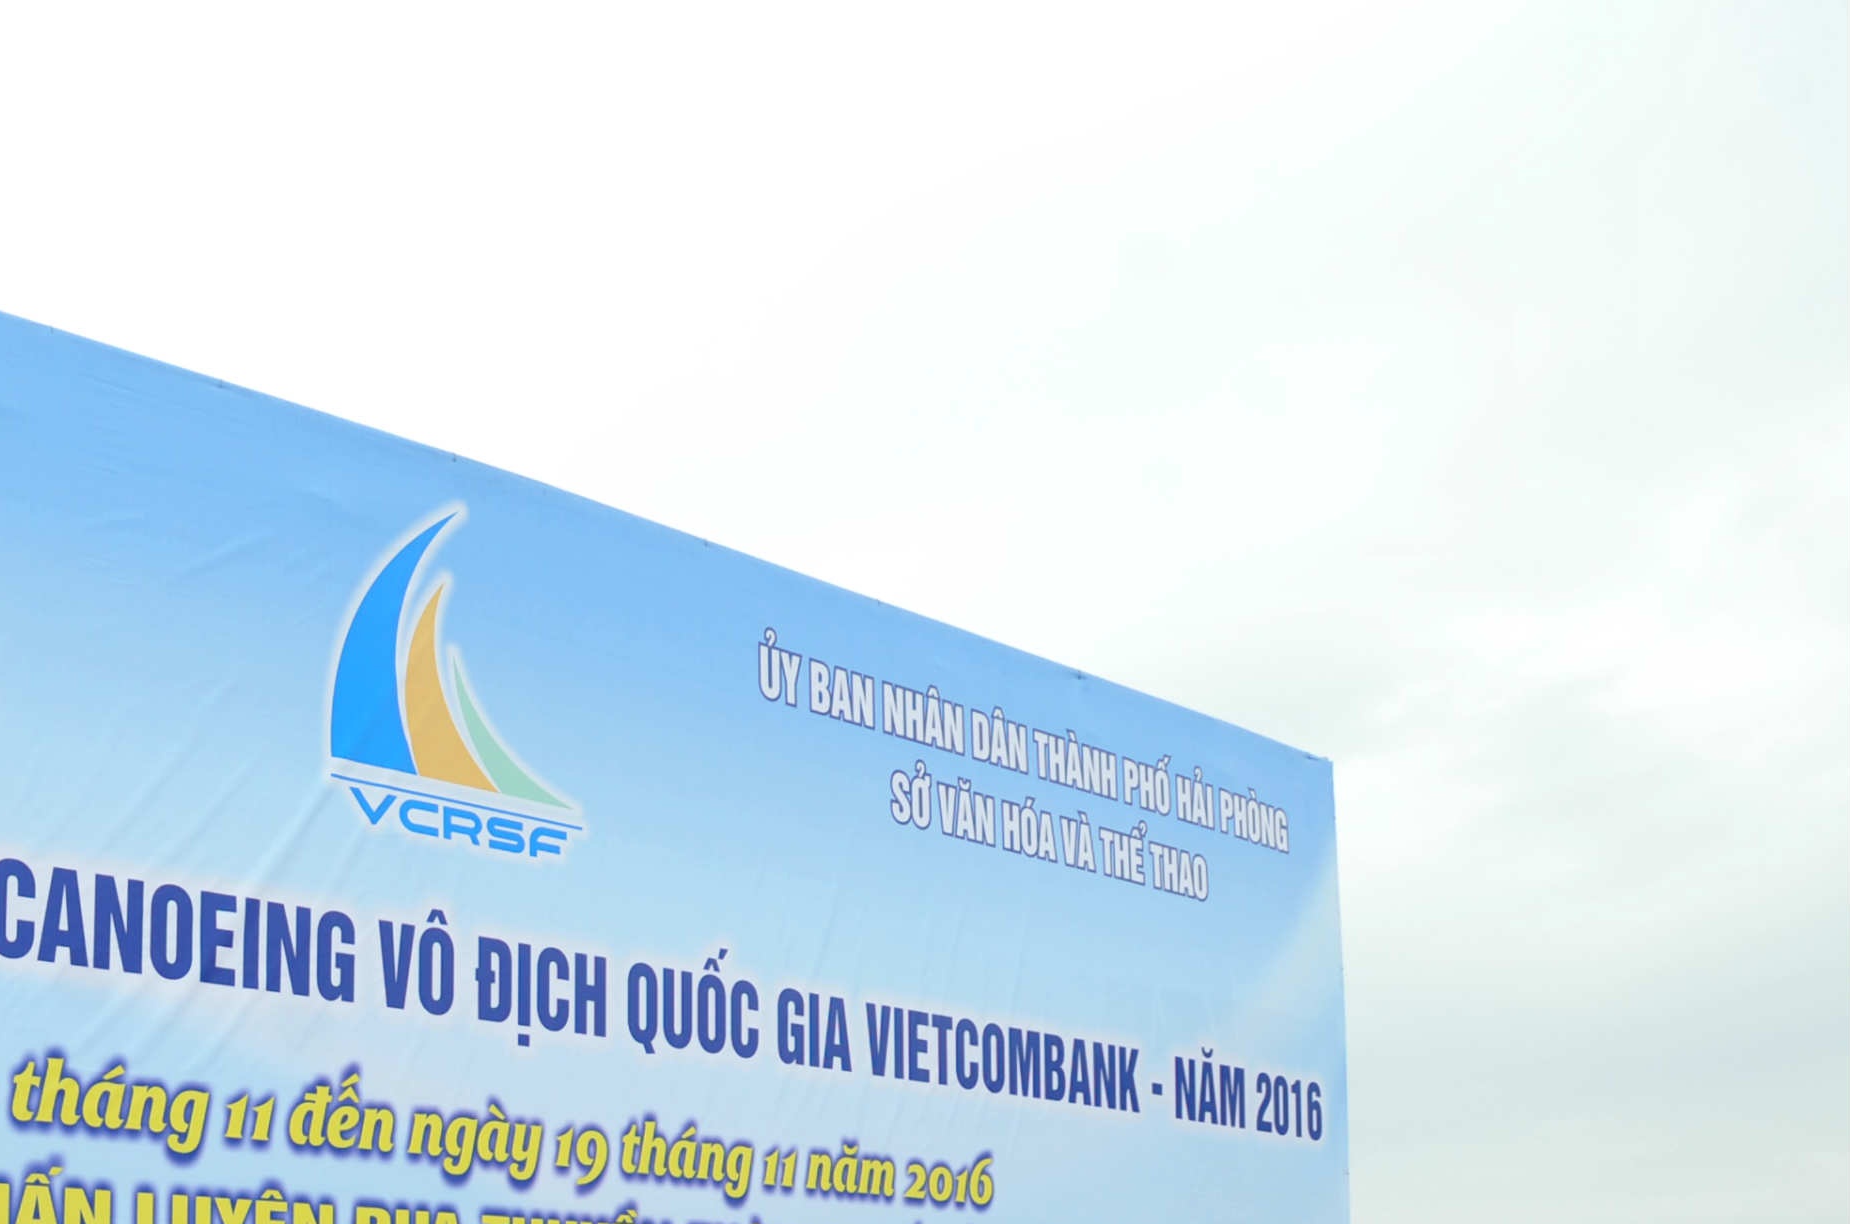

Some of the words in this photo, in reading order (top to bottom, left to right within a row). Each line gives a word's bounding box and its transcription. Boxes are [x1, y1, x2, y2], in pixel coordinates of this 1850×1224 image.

[758, 628, 801, 706] ỦY
[809, 658, 876, 730] BAN
[882, 685, 965, 756] NHÂN
[972, 707, 1028, 773] DÂN
[1033, 729, 1117, 800] THÀNH
[1123, 756, 1171, 816] PHỐ
[1176, 765, 1214, 830] HẢI
[1220, 788, 1290, 853] PHÒNG
[349, 786, 568, 857] VCRSF
[891, 760, 932, 829] SỞ
[938, 780, 996, 847] VĂN
[1002, 797, 1057, 864] HÓA
[1061, 812, 1096, 872] VÀ
[1099, 821, 1148, 885] THỂ
[1150, 840, 1208, 901] THAO
[378, 909, 454, 1015] VÔ
[475, 936, 607, 1047] ĐỊCH
[627, 949, 759, 1059] QUỐC
[777, 988, 852, 1072] GIA
[866, 1002, 1140, 1113] VIETCOMBANK
[1152, 1083, 1163, 1096] -
[1175, 1046, 1246, 1129] NĂM
[1256, 1072, 1323, 1141] 2016
[11, 1057, 210, 1154] tháng
[225, 1099, 272, 1142] 11
[289, 1073, 394, 1151] đến
[407, 1104, 542, 1176] ngày
[555, 1129, 609, 1186] 19
[621, 1121, 752, 1197] tháng
[763, 1149, 797, 1187] 11
[806, 1145, 894, 1196] năm
[906, 1157, 994, 1205] 2016
